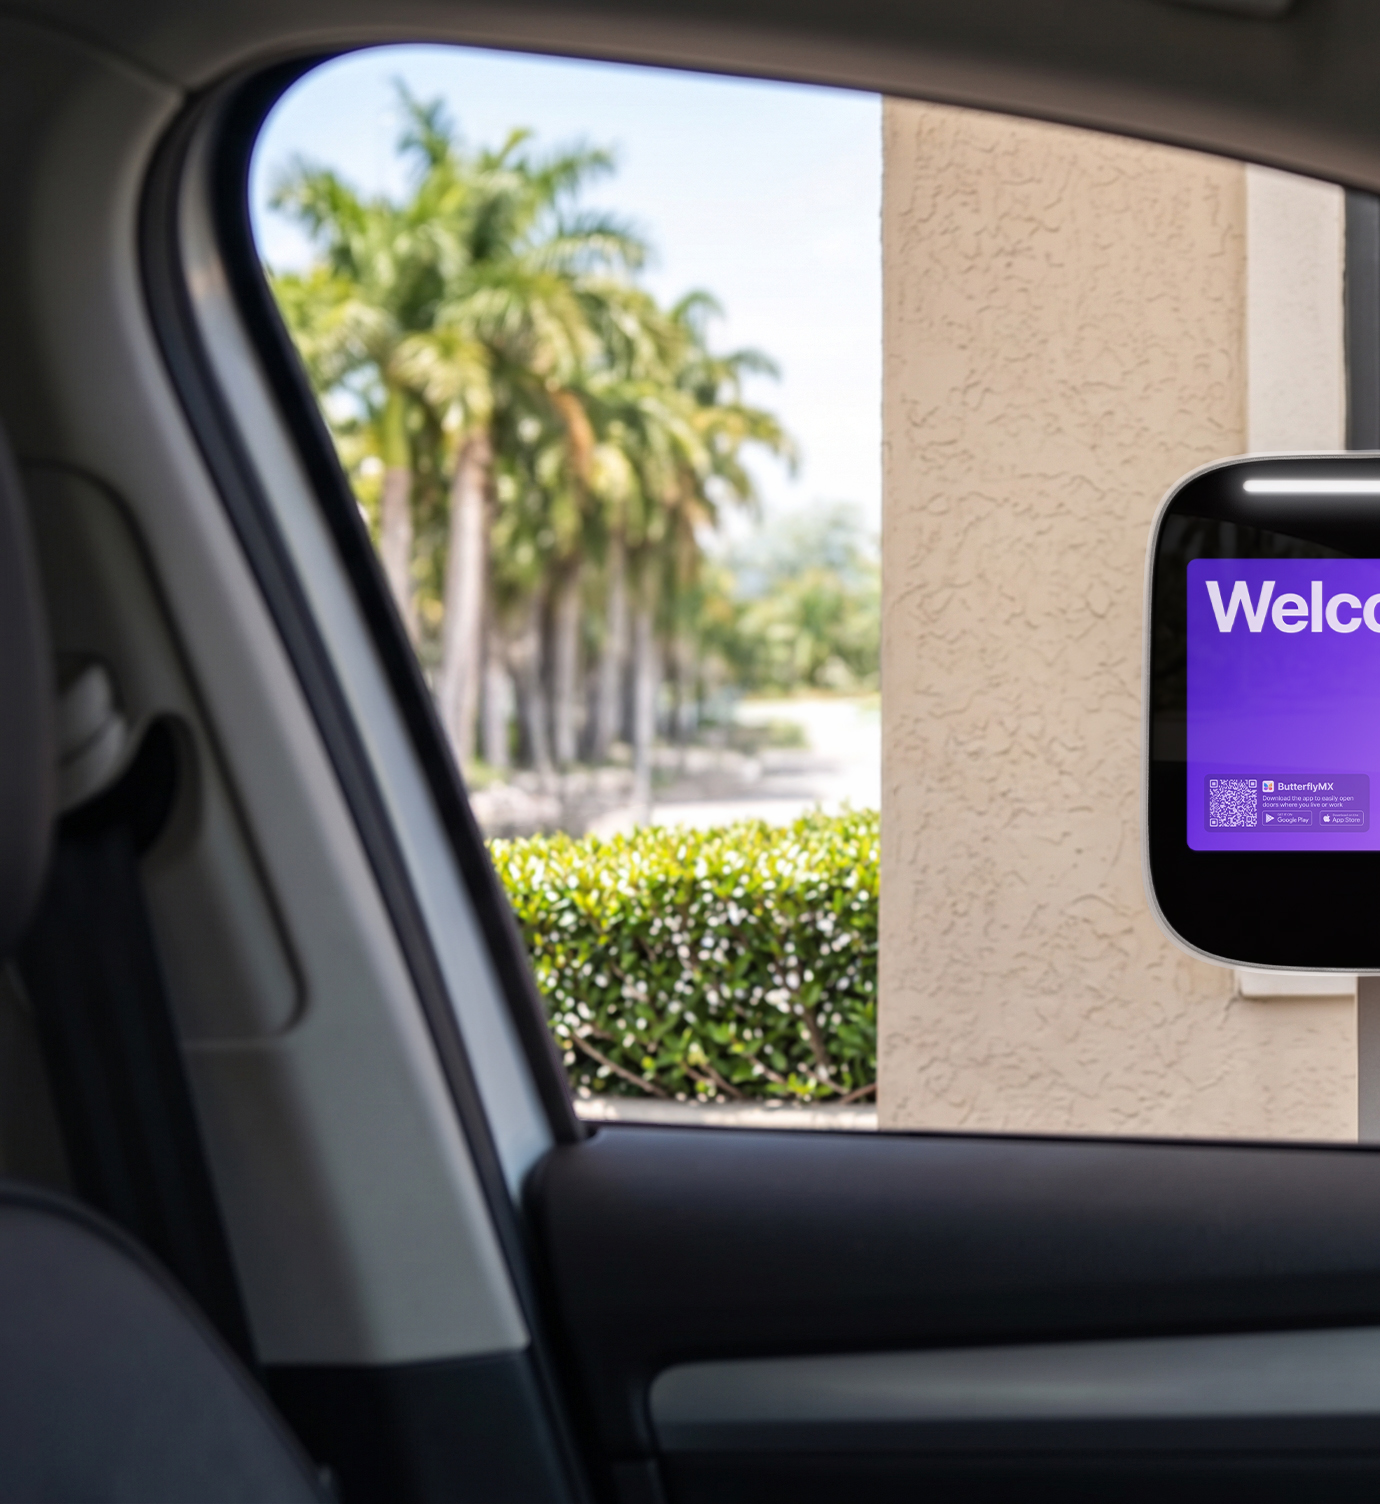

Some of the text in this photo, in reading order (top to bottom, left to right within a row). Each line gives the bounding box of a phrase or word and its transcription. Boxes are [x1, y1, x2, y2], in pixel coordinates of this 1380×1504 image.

[1277, 782, 1334, 793] ButterflyMX
[1321, 795, 1338, 803] easily
[1277, 816, 1310, 824] Google Play
[1332, 816, 1345, 824] App
